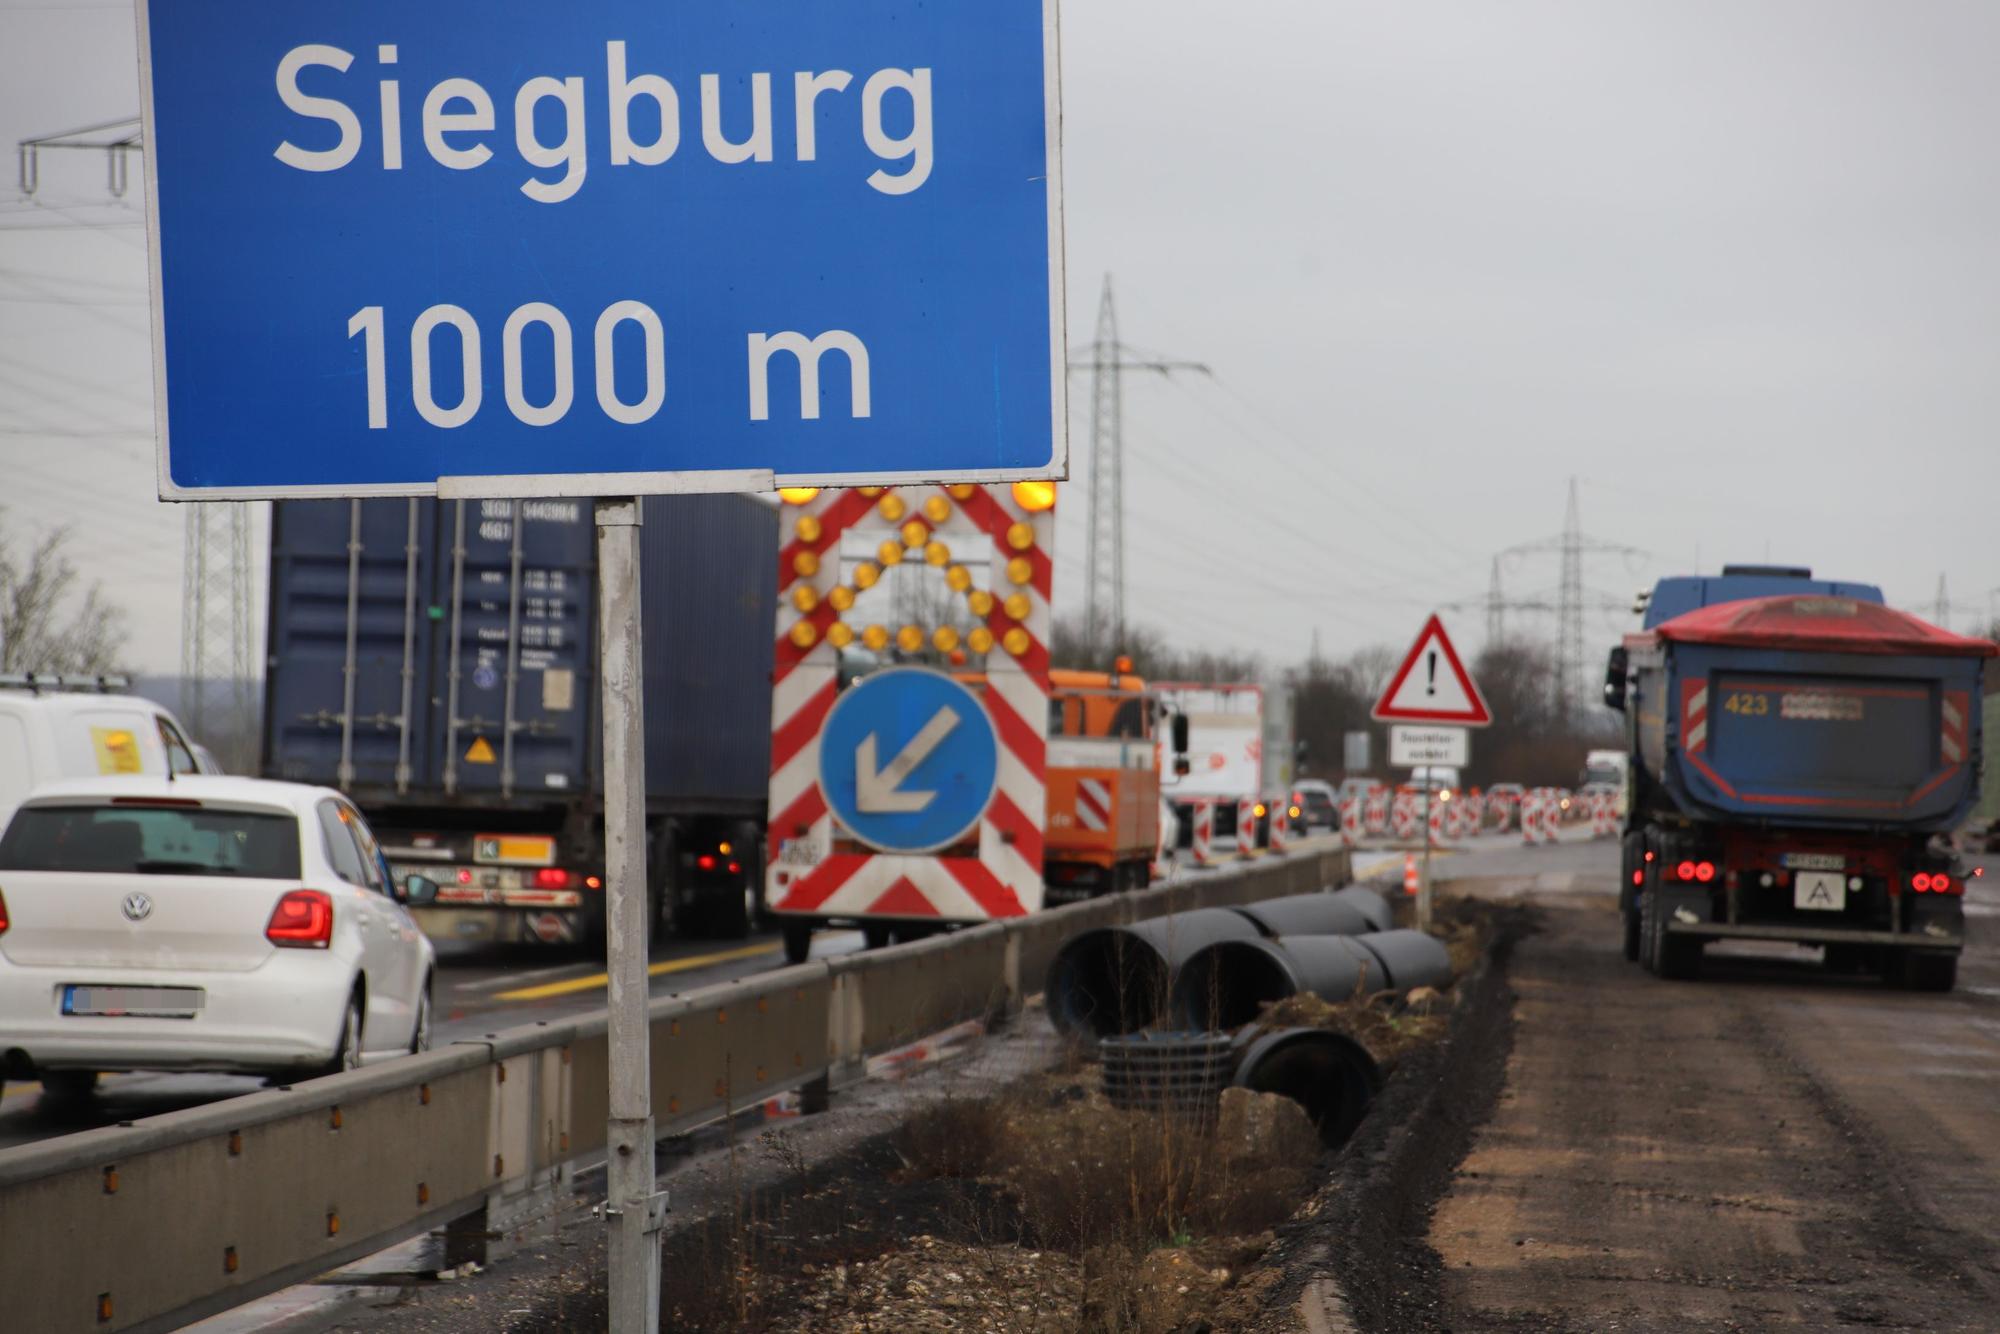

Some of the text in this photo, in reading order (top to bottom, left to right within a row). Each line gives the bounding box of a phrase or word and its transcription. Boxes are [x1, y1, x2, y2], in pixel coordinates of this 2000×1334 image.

[273, 40, 933, 203] Siegburg
[348, 300, 870, 428] 1000 m
[1724, 694, 1768, 716] 423
[1806, 879, 1833, 905] A
